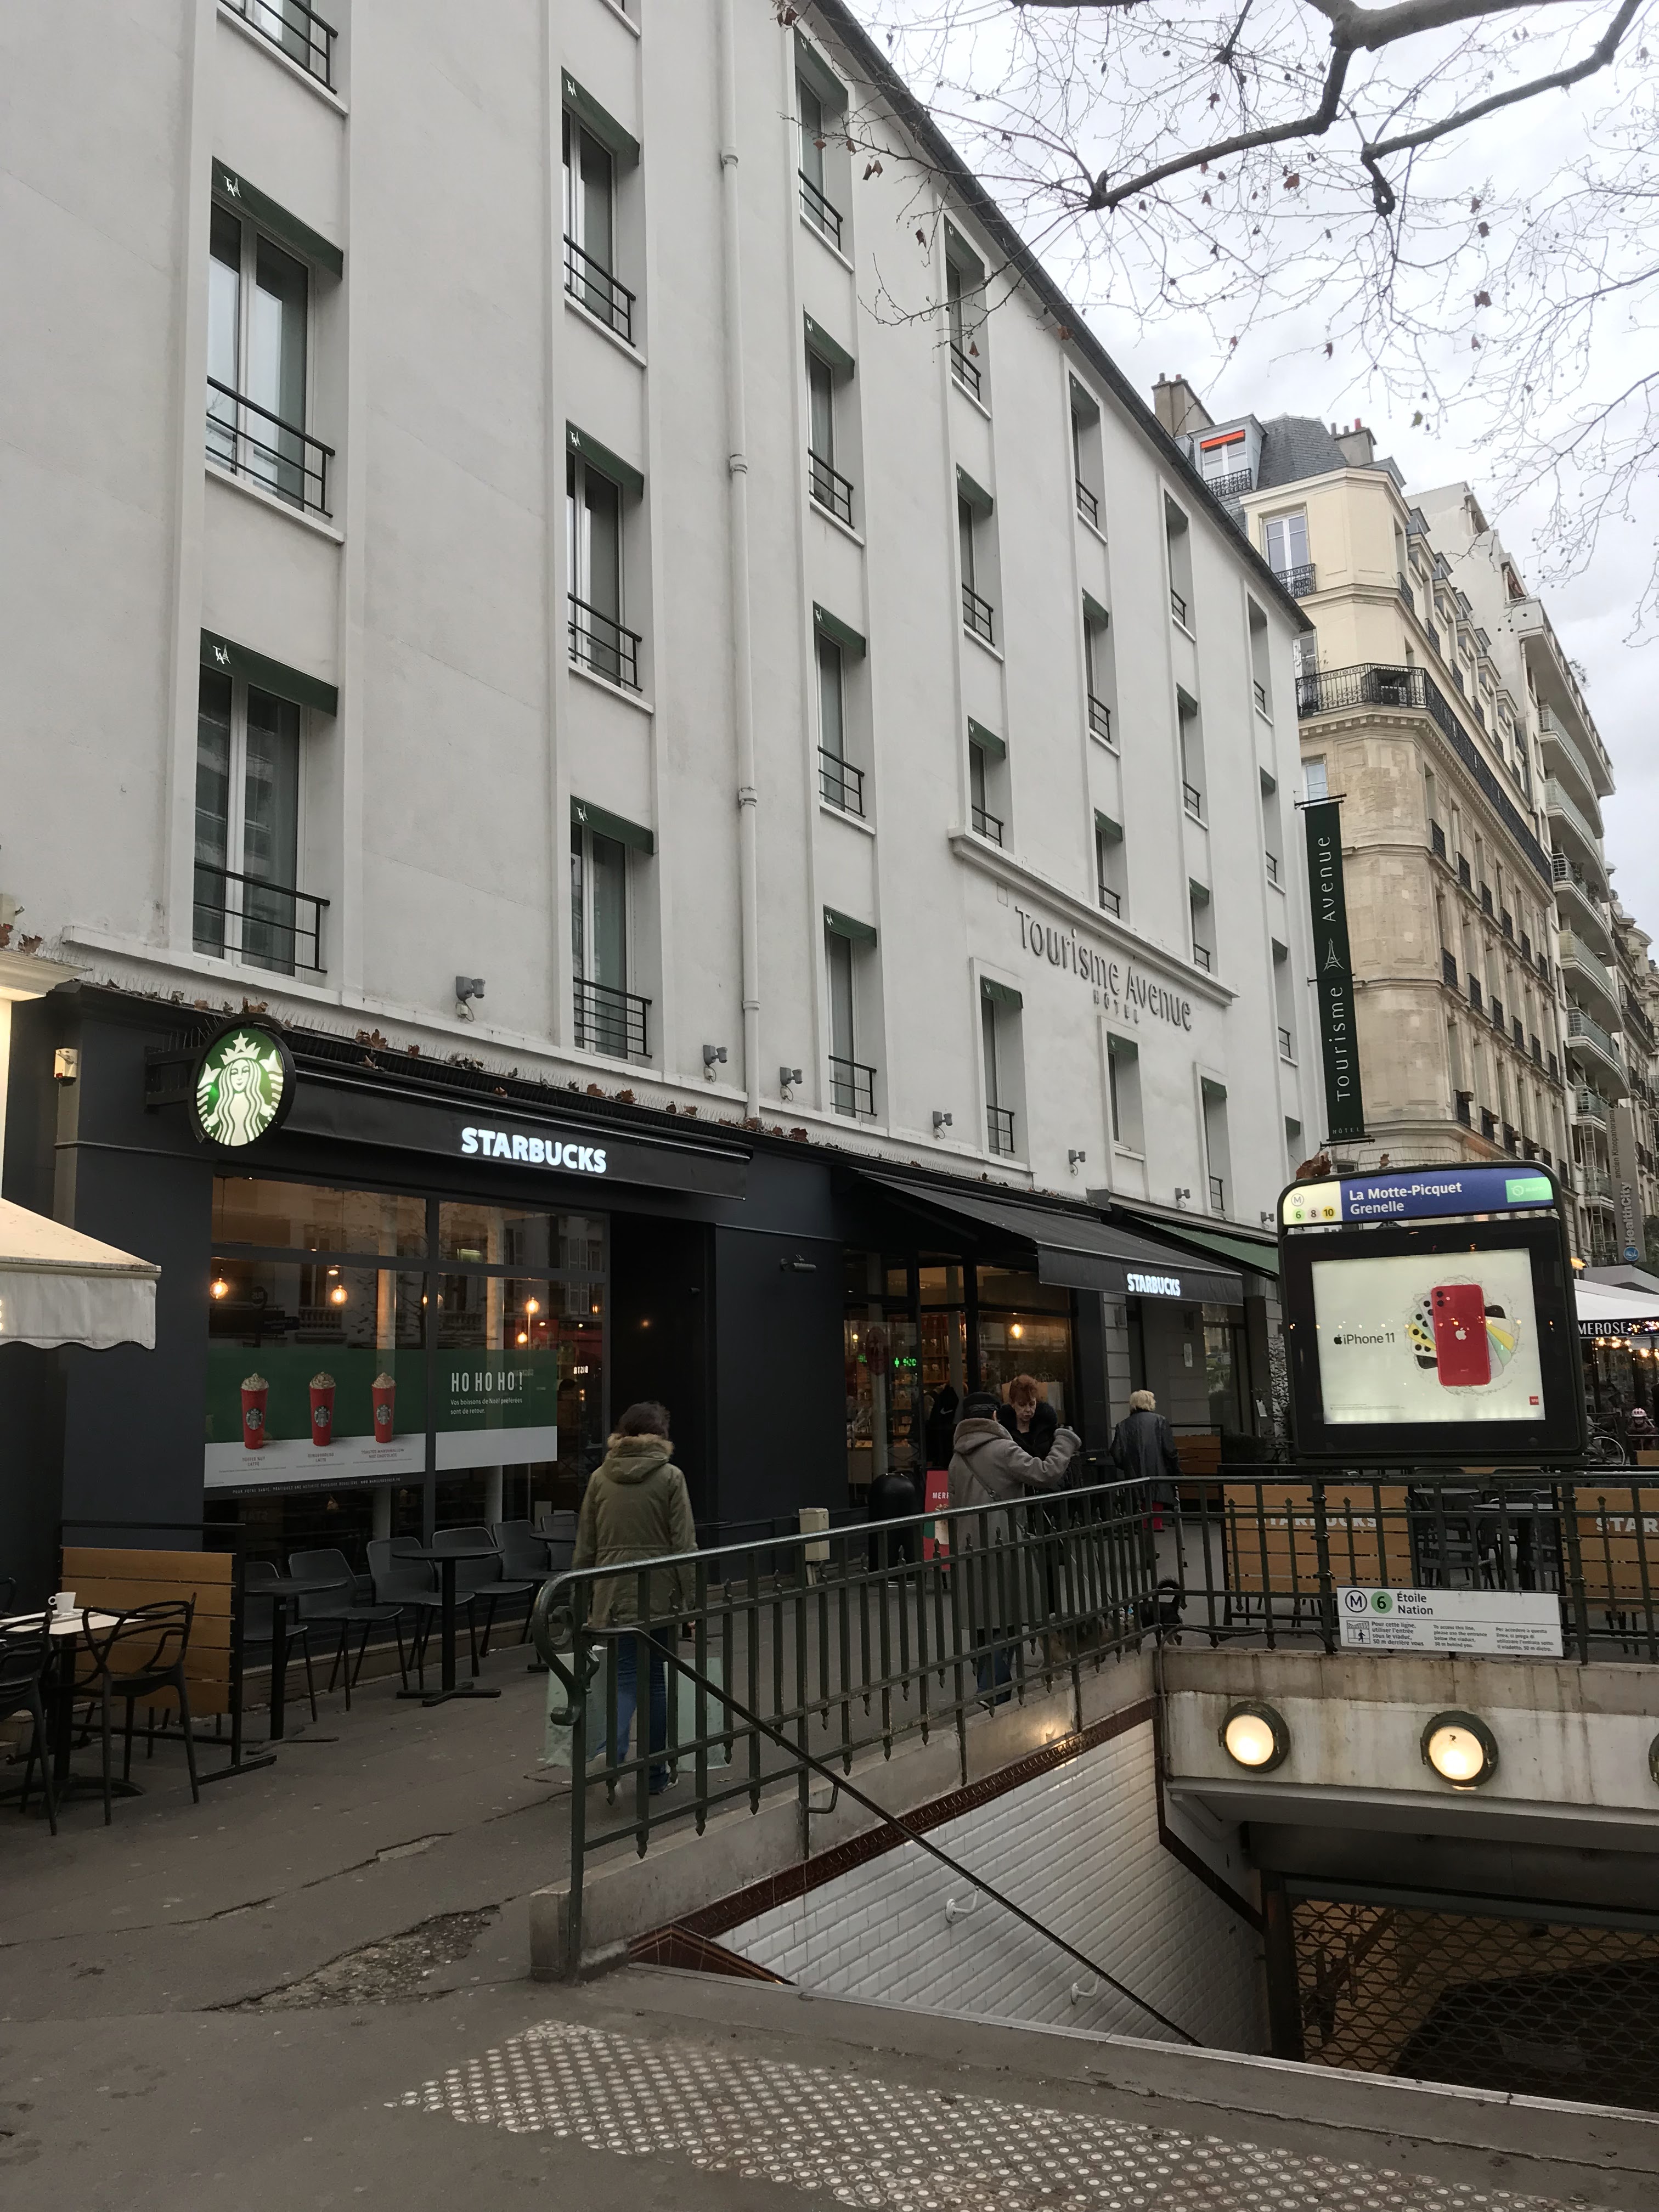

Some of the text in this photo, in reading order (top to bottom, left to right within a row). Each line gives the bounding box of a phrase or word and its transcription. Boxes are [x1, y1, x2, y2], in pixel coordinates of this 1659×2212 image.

[1015, 906, 1192, 1032] Tourisme Avenue
[1318, 837, 1351, 1102] Tourisme Avenue
[461, 1127, 607, 1173] STARBUCKS
[1349, 1182, 1463, 1200] La Motte-Picquet
[1295, 1209, 1334, 1219] 6 8 10
[1350, 1200, 1404, 1215] Grenelle
[1621, 1182, 1636, 1246] HealthCity
[1126, 1273, 1181, 1297] STARBUCKS
[1343, 1332, 1395, 1345] iPhone 11
[451, 1372, 470, 1392] HO
[475, 1372, 493, 1392] HO
[1377, 1595, 1386, 1610] 6
[1397, 1591, 1427, 1602] Étoile
[1398, 1605, 1434, 1615] Nation
